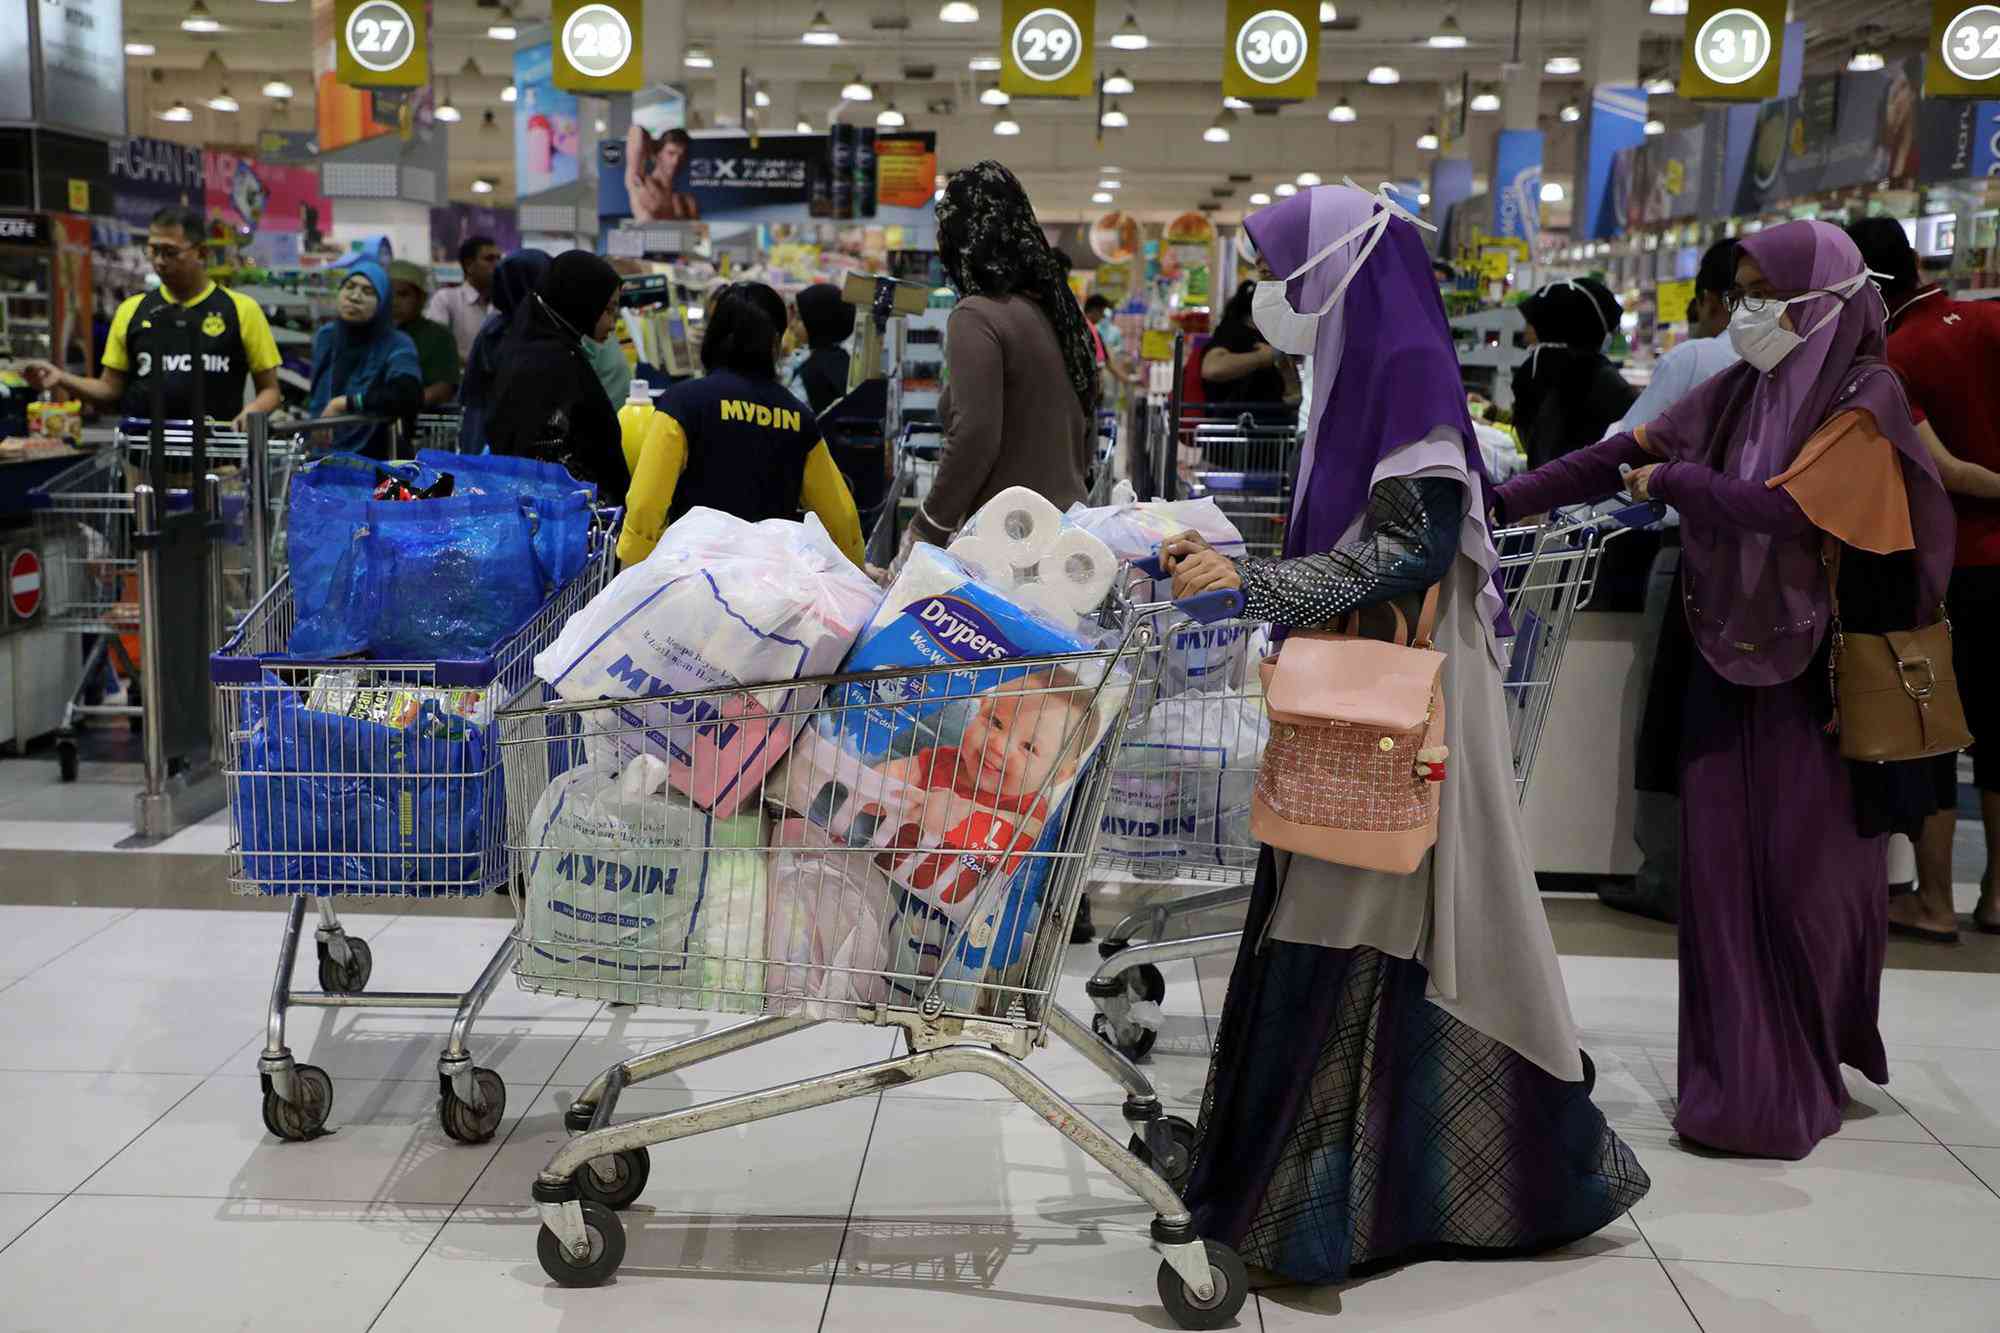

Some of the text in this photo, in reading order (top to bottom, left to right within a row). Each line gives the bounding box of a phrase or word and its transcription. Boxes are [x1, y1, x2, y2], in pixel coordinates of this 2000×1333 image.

[356, 20, 405, 52] 27
[573, 23, 622, 57] 28
[1022, 28, 1072, 62] 29
[1246, 30, 1297, 65] 30
[1709, 28, 1757, 64] 31
[1954, 25, 2000, 61] 32
[720, 399, 801, 432] MYDIN
[920, 599, 1009, 660] Drypers
[606, 654, 740, 751] MYDIN
[1101, 815, 1197, 837] MYDIN
